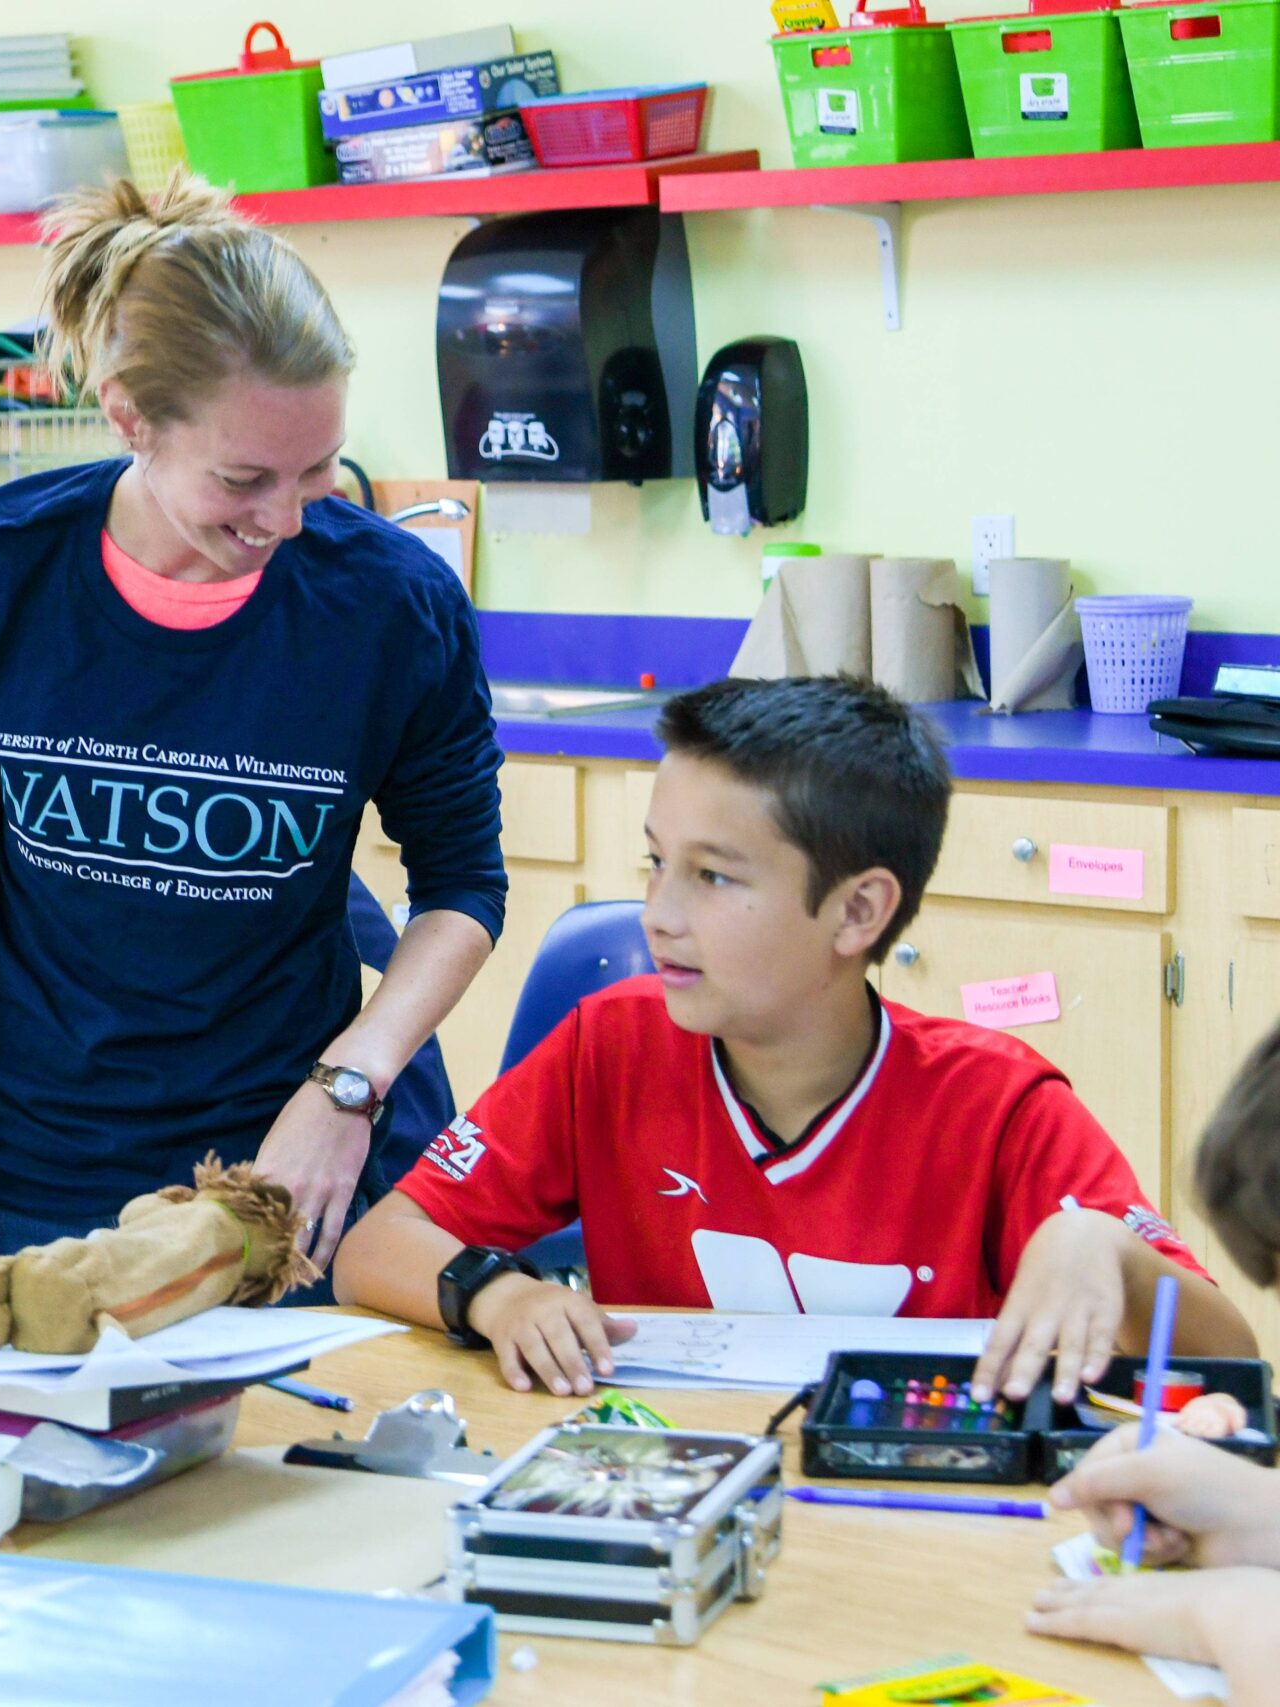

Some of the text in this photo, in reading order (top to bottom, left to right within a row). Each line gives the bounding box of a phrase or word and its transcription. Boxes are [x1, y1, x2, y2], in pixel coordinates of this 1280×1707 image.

[56, 737, 75, 755] of
[76, 736, 138, 760] NORTH
[142, 744, 230, 771] CAROLINA
[17, 839, 273, 901] WATSON COLLEGE of EDUCATION
[1068, 856, 1124, 872] Envelopes
[990, 982, 1029, 996] Teacher
[974, 993, 1052, 1013] Resource Books
[448, 1135, 488, 1174] 21
